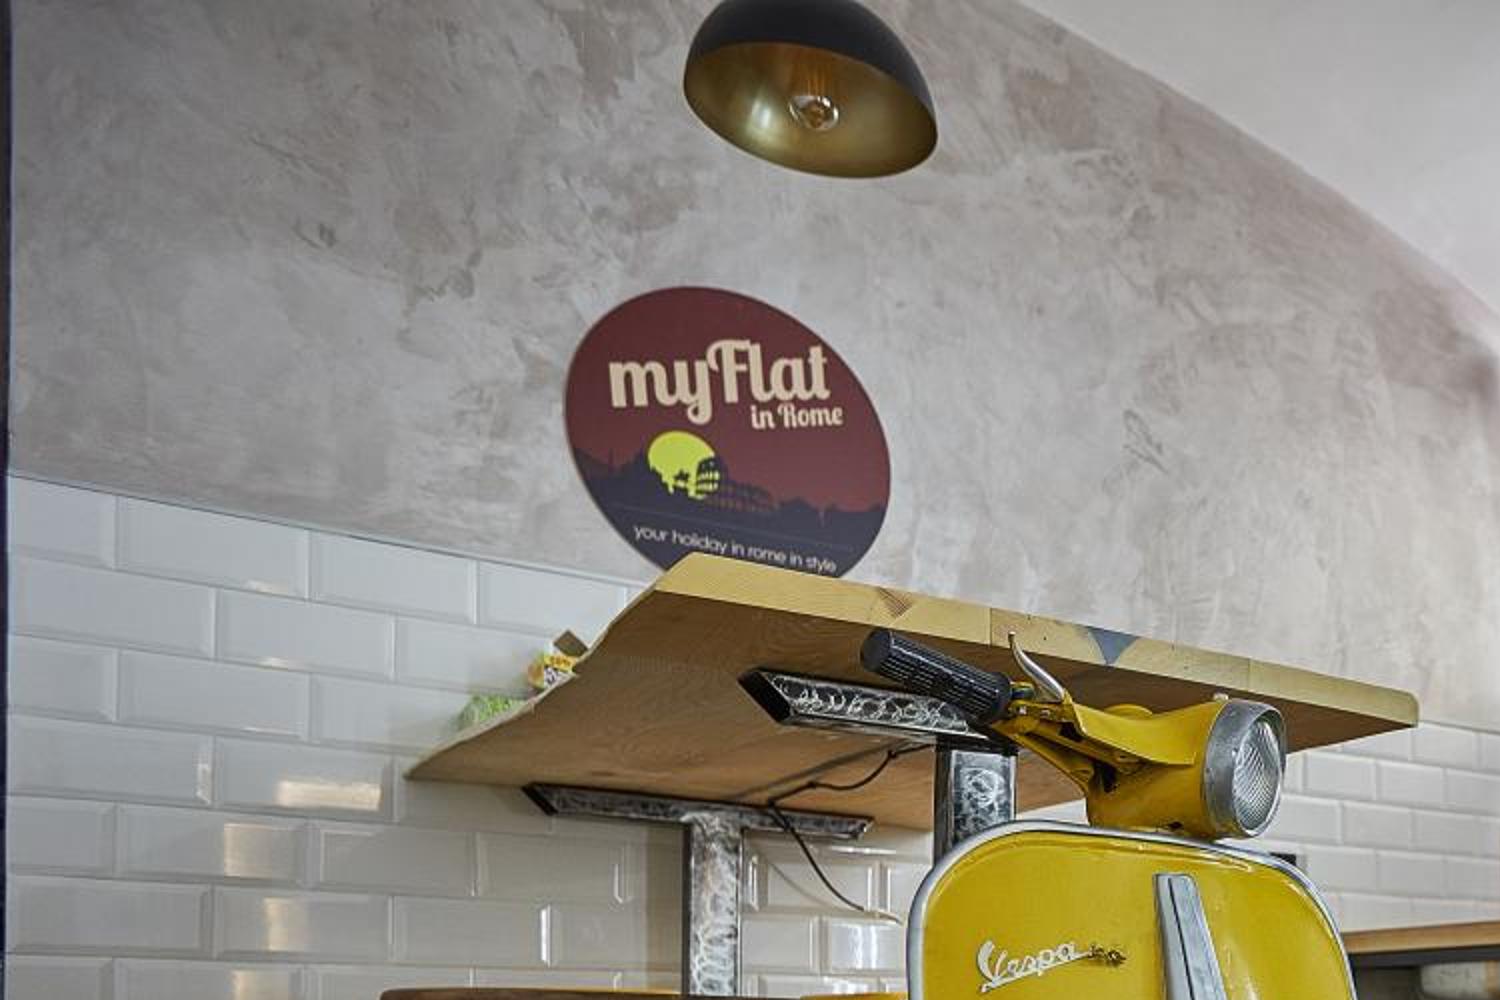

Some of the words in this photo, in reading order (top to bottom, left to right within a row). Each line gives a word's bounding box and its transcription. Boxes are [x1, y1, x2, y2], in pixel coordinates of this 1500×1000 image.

[609, 339, 831, 425] myFlat
[751, 404, 775, 430] in
[777, 402, 843, 429] Rome
[634, 524, 668, 541] your
[671, 528, 727, 555] holiday
[730, 540, 745, 556] in
[748, 545, 786, 563] rome
[789, 551, 803, 567] in
[805, 556, 837, 574] style
[977, 940, 1092, 993] Vespa
